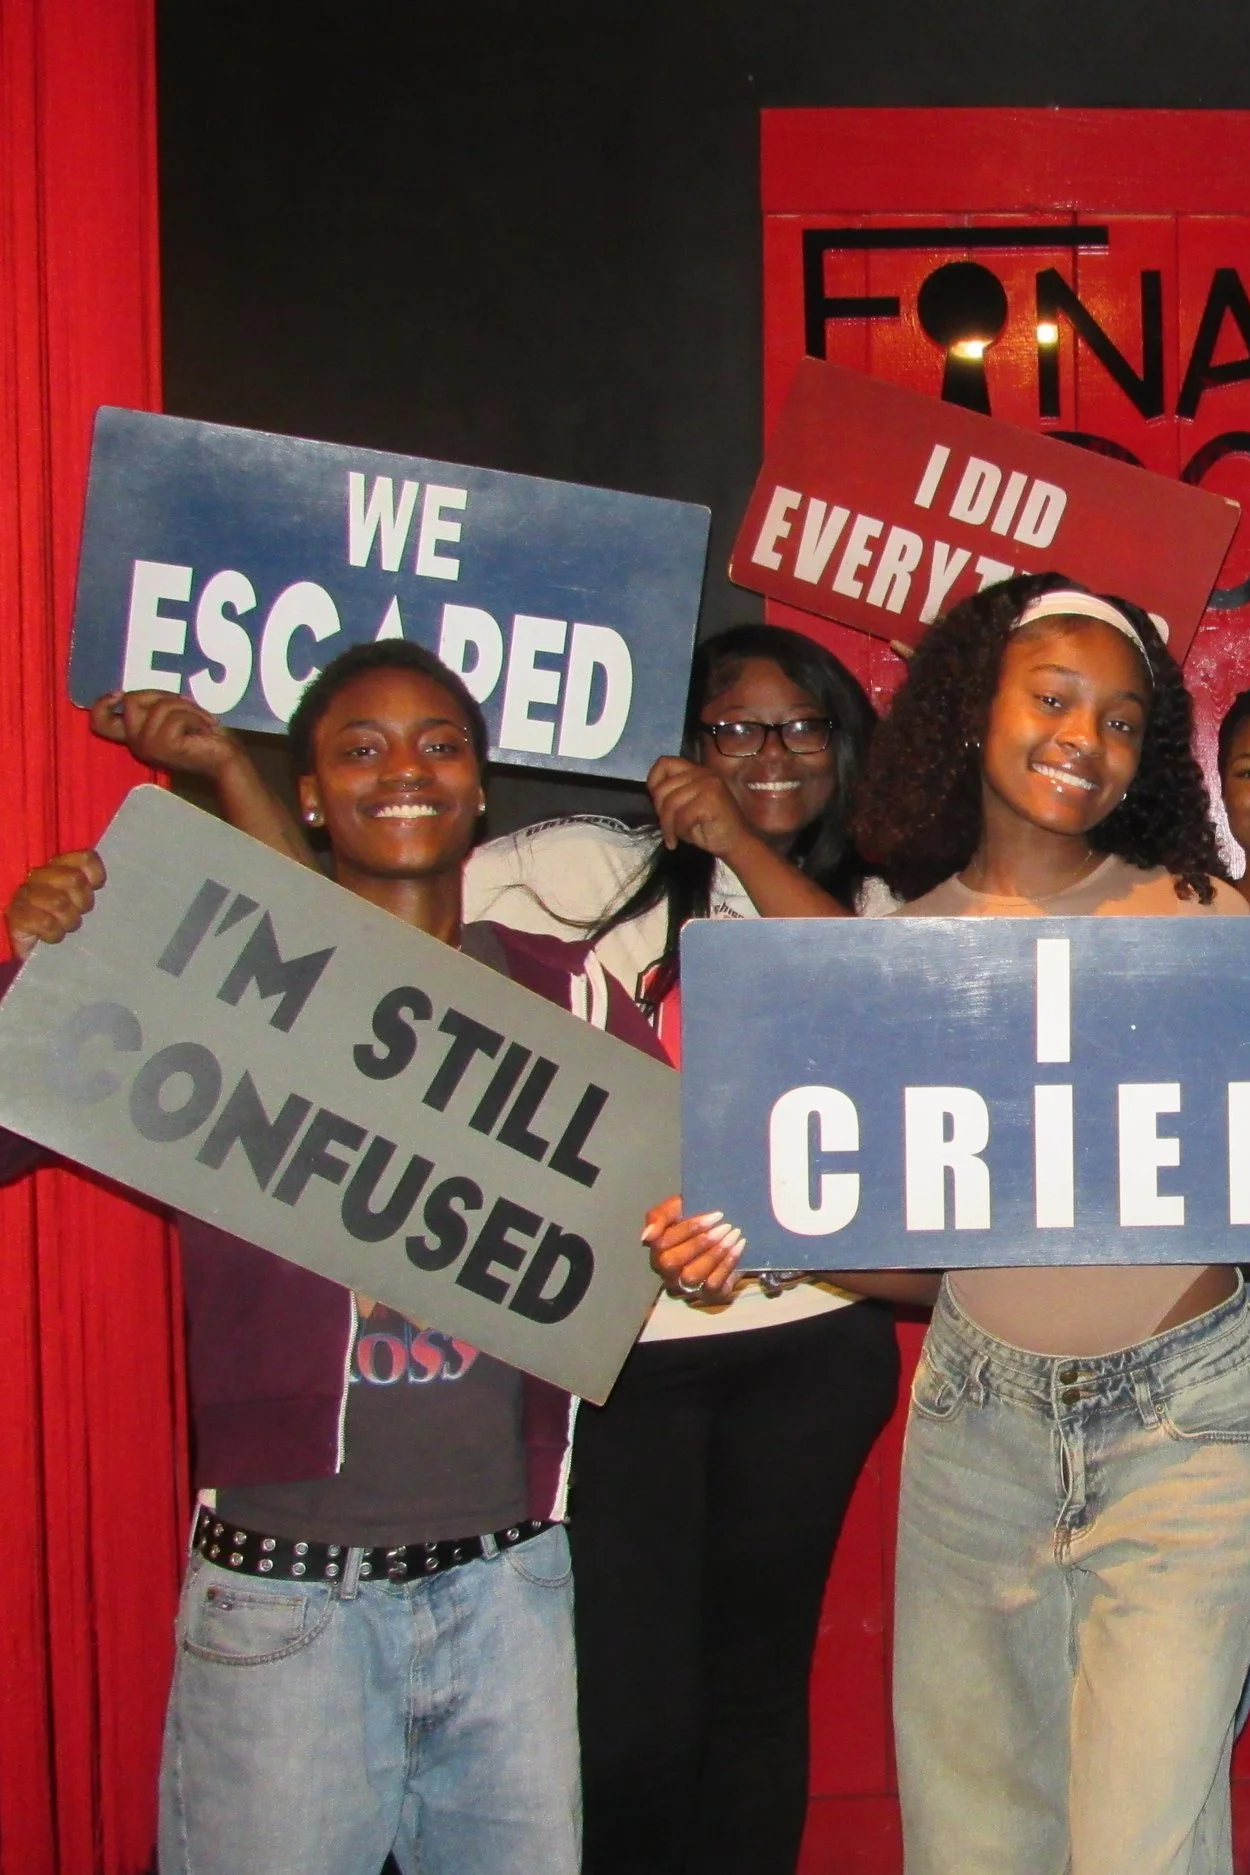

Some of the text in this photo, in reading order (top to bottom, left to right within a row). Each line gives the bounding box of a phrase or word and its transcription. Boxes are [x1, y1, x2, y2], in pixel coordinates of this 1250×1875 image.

[348, 472, 468, 581] WE
[914, 443, 1068, 549] I DID
[156, 878, 610, 1189] I'M STILL
[1036, 938, 1071, 1063] I
[43, 1002, 595, 1325] CONFUSED
